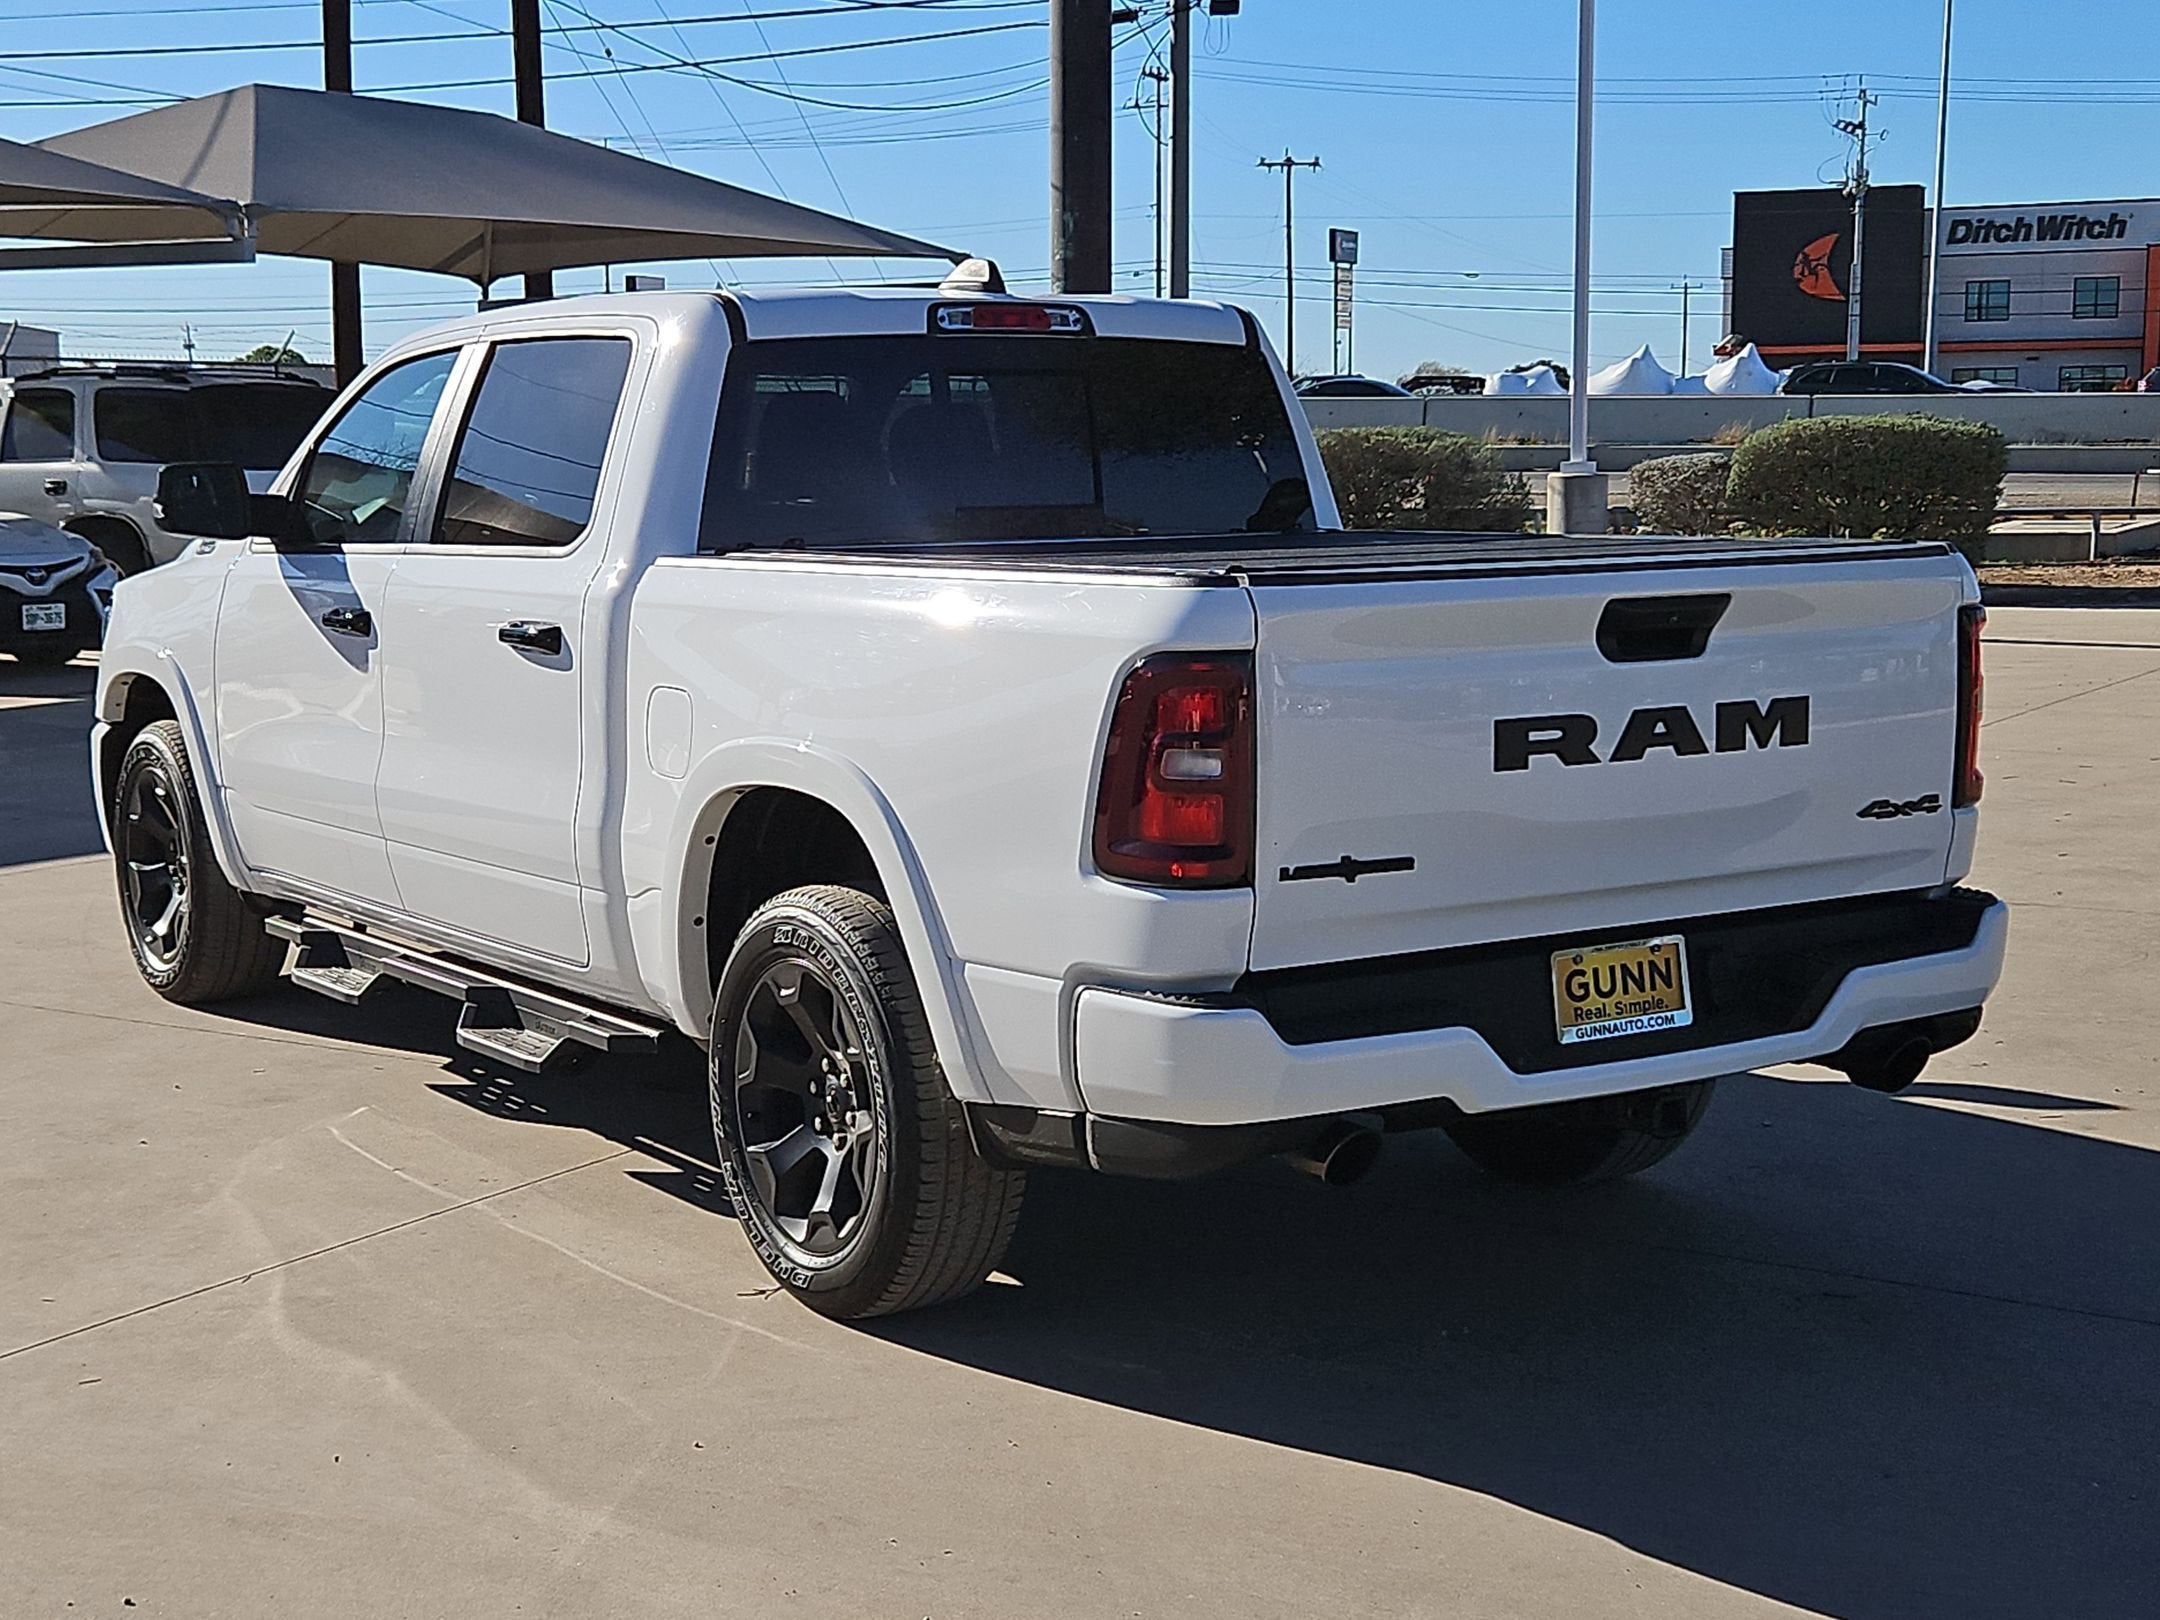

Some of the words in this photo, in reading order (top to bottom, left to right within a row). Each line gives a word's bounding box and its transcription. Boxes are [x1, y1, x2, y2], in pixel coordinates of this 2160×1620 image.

[1946, 216, 2034, 245] Ditch
[2036, 212, 2128, 242] Witch
[1493, 695, 1810, 772] RAM
[1564, 956, 1674, 1004] GUNN
[1573, 1002, 1612, 1022] Real.
[1614, 995, 1669, 1017] Simple.
[1575, 1013, 1677, 1040] GUNNAUTO.COM
